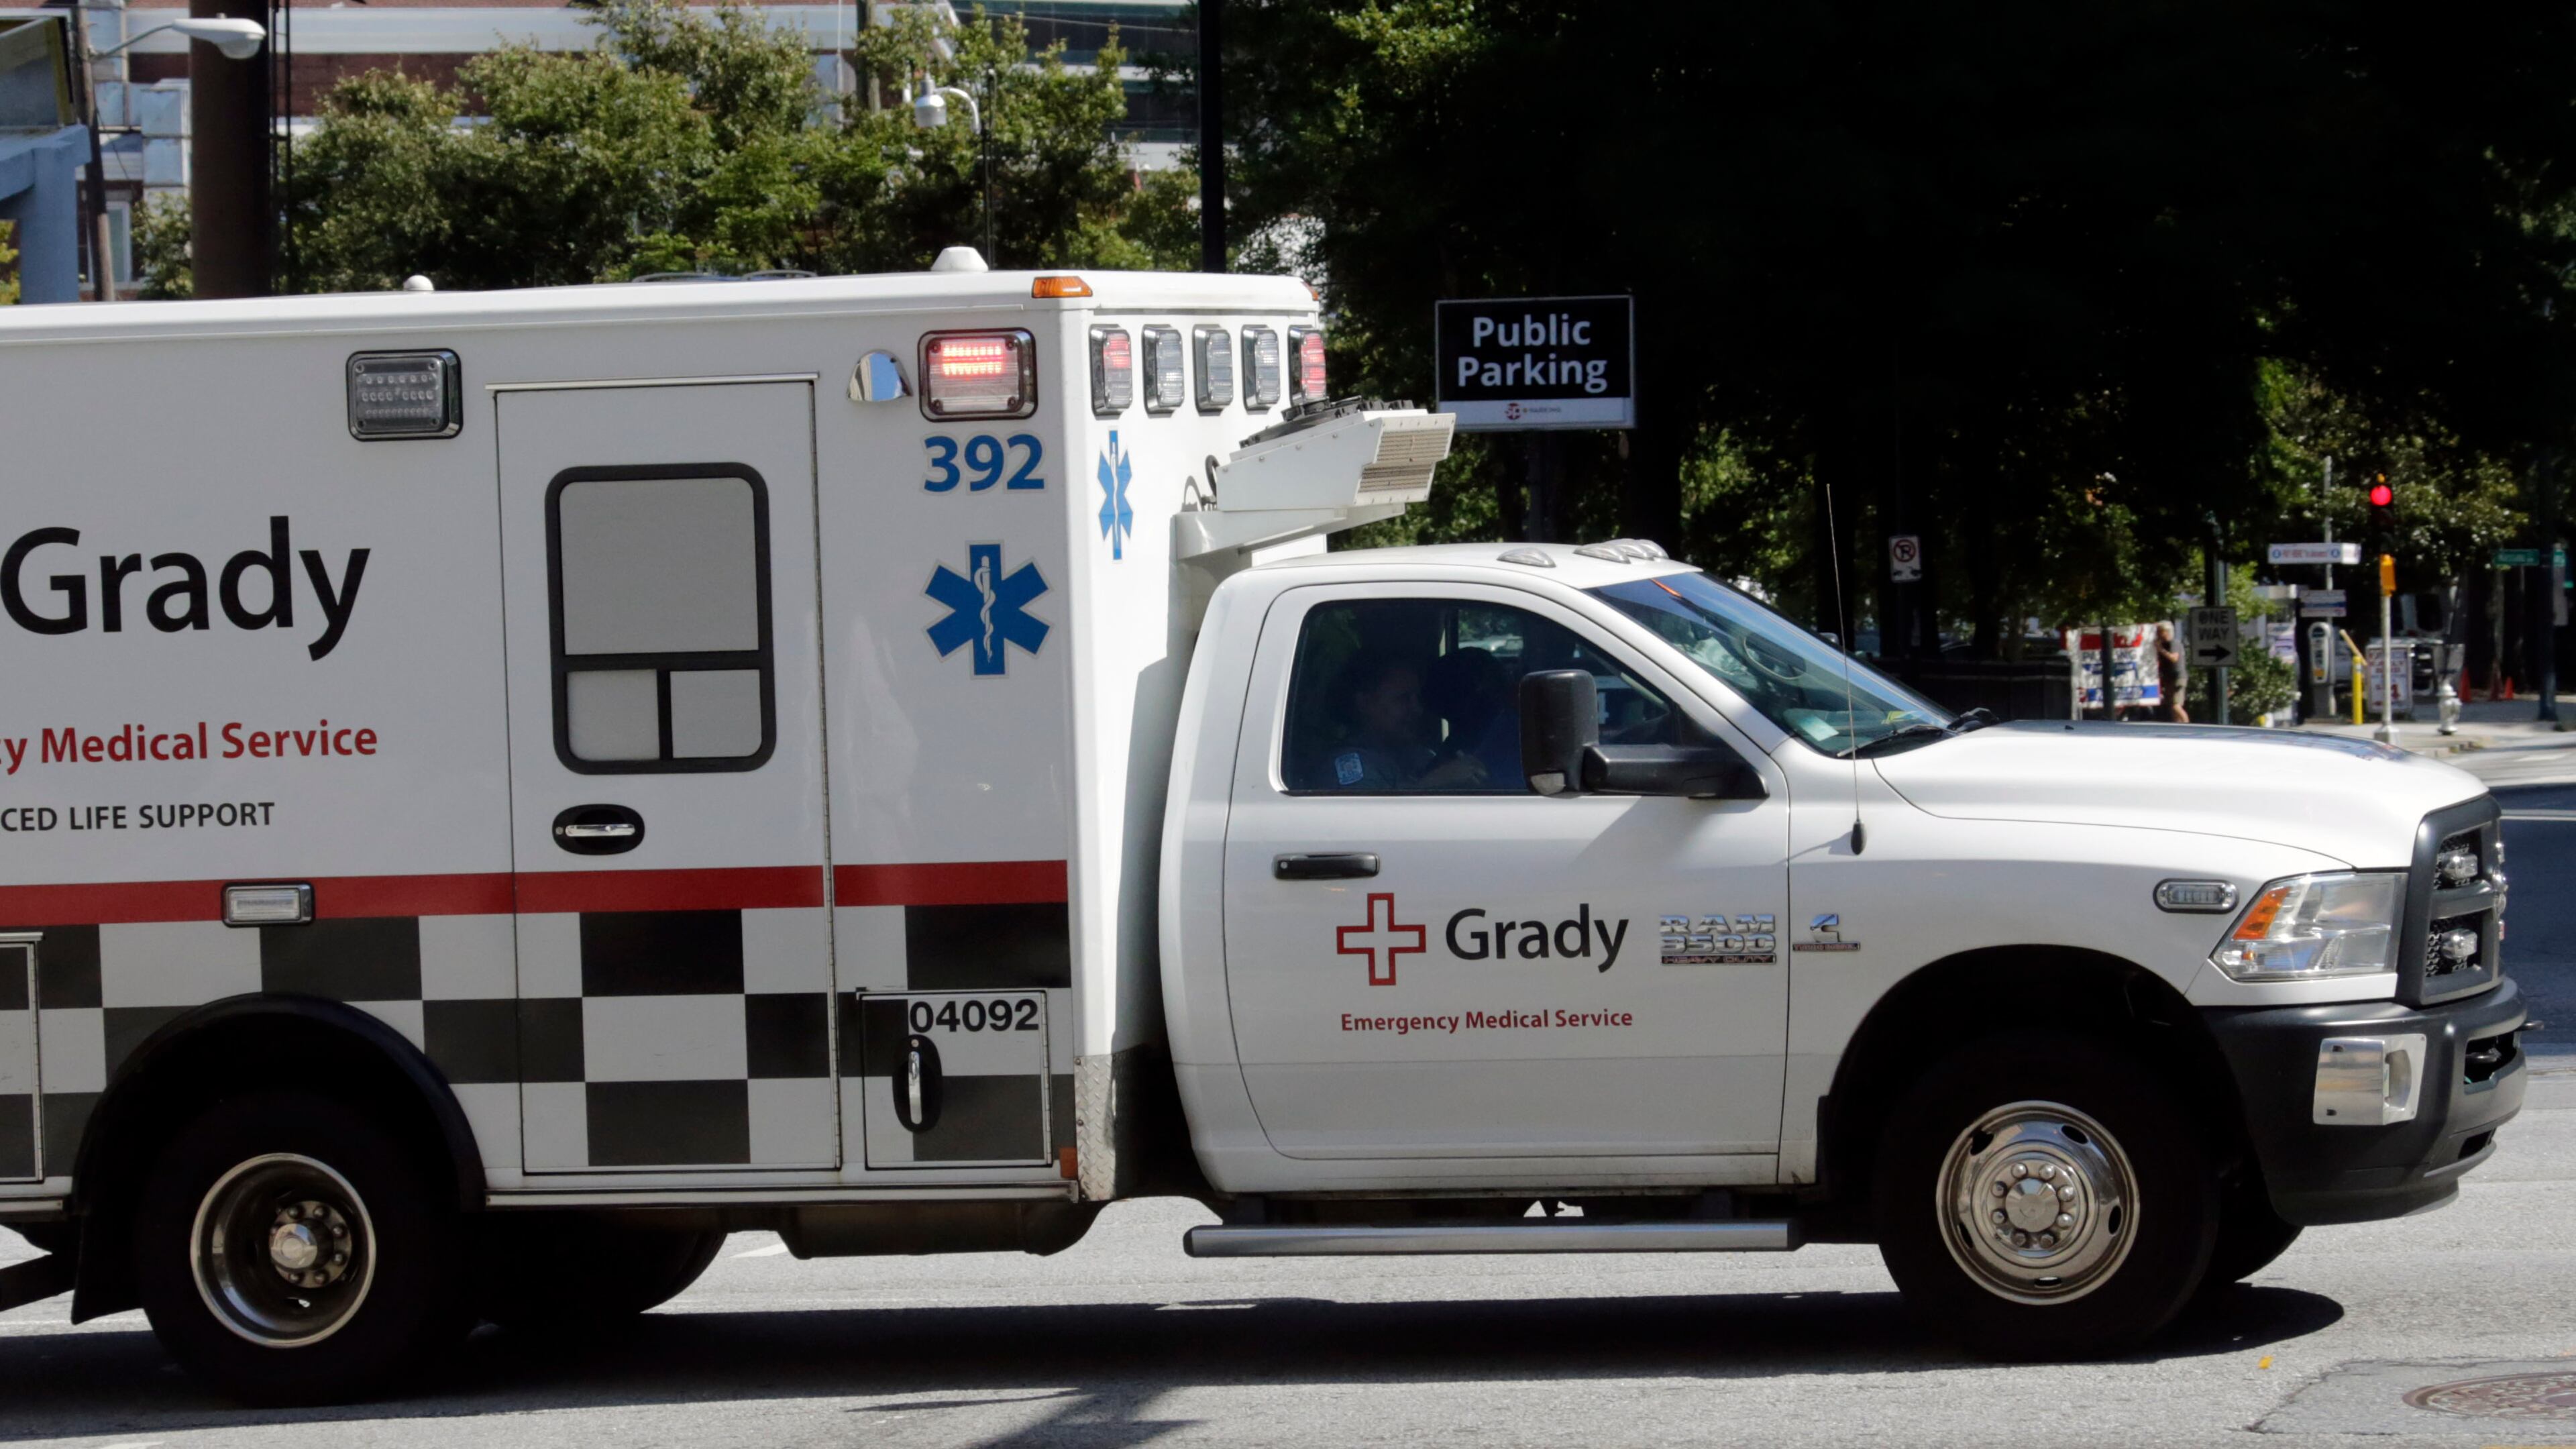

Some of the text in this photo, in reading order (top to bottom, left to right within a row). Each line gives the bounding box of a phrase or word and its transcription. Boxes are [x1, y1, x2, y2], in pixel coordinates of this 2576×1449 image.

[1472, 313, 1591, 347] Public
[1457, 353, 1607, 393] Parking
[923, 433, 1044, 492] 392
[0, 515, 371, 661] Grady
[2198, 627, 2230, 641] WAY
[2199, 611, 2229, 625] ONE
[0, 718, 378, 775] y Medical Service
[1, 802, 275, 831] CED LIFE SUPPORT
[1445, 903, 1629, 973] Grady
[1660, 914, 1776, 933] RAM
[1660, 934, 1776, 953] 3500
[909, 998, 1039, 1034] 04092
[1341, 1008, 1633, 1035] Emergency Medical Service
